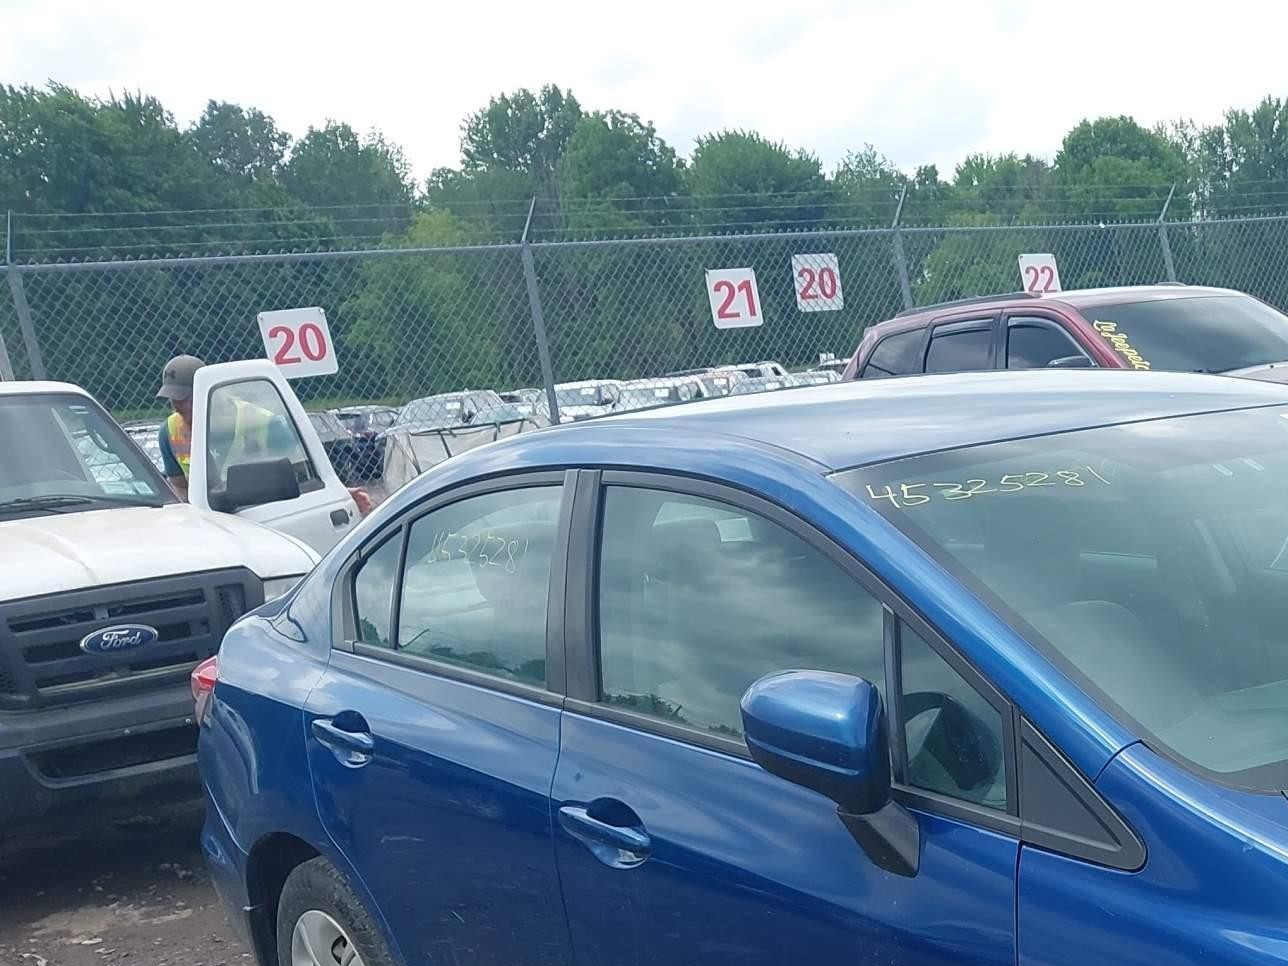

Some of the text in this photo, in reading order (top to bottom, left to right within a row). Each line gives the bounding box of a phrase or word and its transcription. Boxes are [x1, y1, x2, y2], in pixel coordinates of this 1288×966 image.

[798, 266, 837, 300] 20
[1024, 265, 1058, 293] 22
[713, 279, 757, 319] 21
[269, 322, 328, 365] 20
[866, 465, 1111, 508] 45325281
[100, 629, 142, 650] Ford
